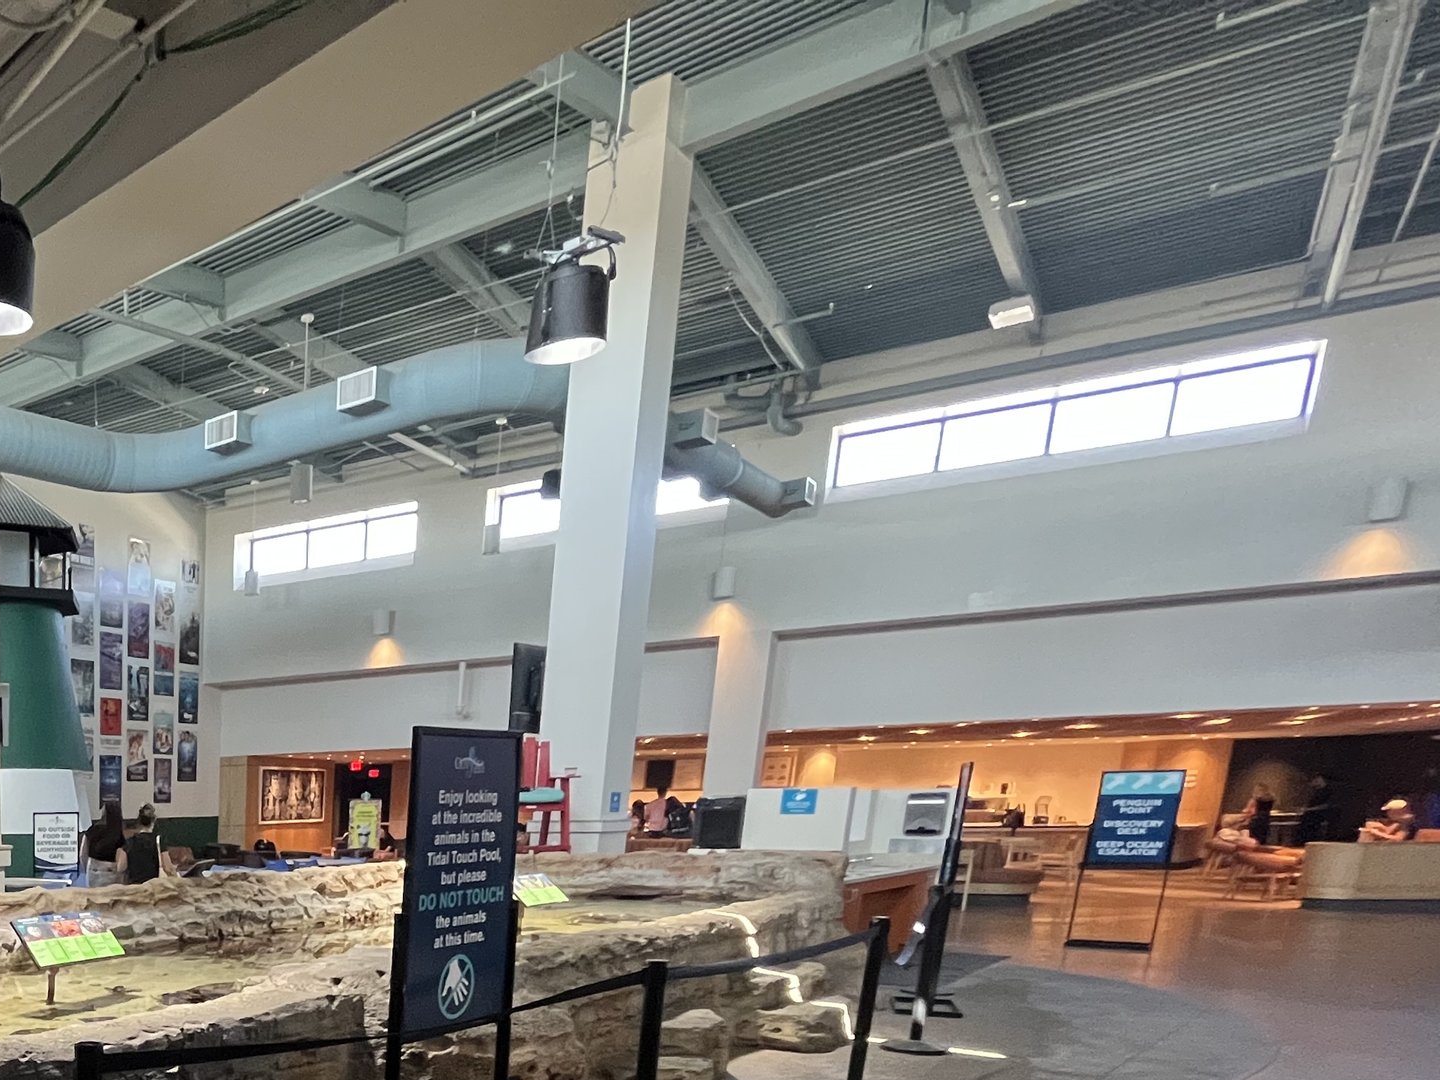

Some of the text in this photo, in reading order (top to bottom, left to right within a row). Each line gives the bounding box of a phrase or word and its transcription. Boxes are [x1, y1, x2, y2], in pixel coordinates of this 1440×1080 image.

[439, 789, 498, 807] Enjoy looking
[1112, 799, 1163, 807] PENGUIN
[431, 809, 503, 825] at the incredible
[1119, 806, 1153, 814] POINT
[1103, 819, 1164, 828] DISCOVERY
[1116, 827, 1148, 835] DESK
[434, 828, 496, 846] animals in the
[1096, 840, 1163, 849] DEEP OCEAN
[427, 847, 502, 867] Tidal Touch Pool,
[1098, 848, 1159, 856] ESCALATOR
[440, 869, 487, 887] but please
[418, 885, 505, 912] DO NOT TOUCH
[435, 909, 487, 929] the animals
[433, 930, 485, 949] at this time.
